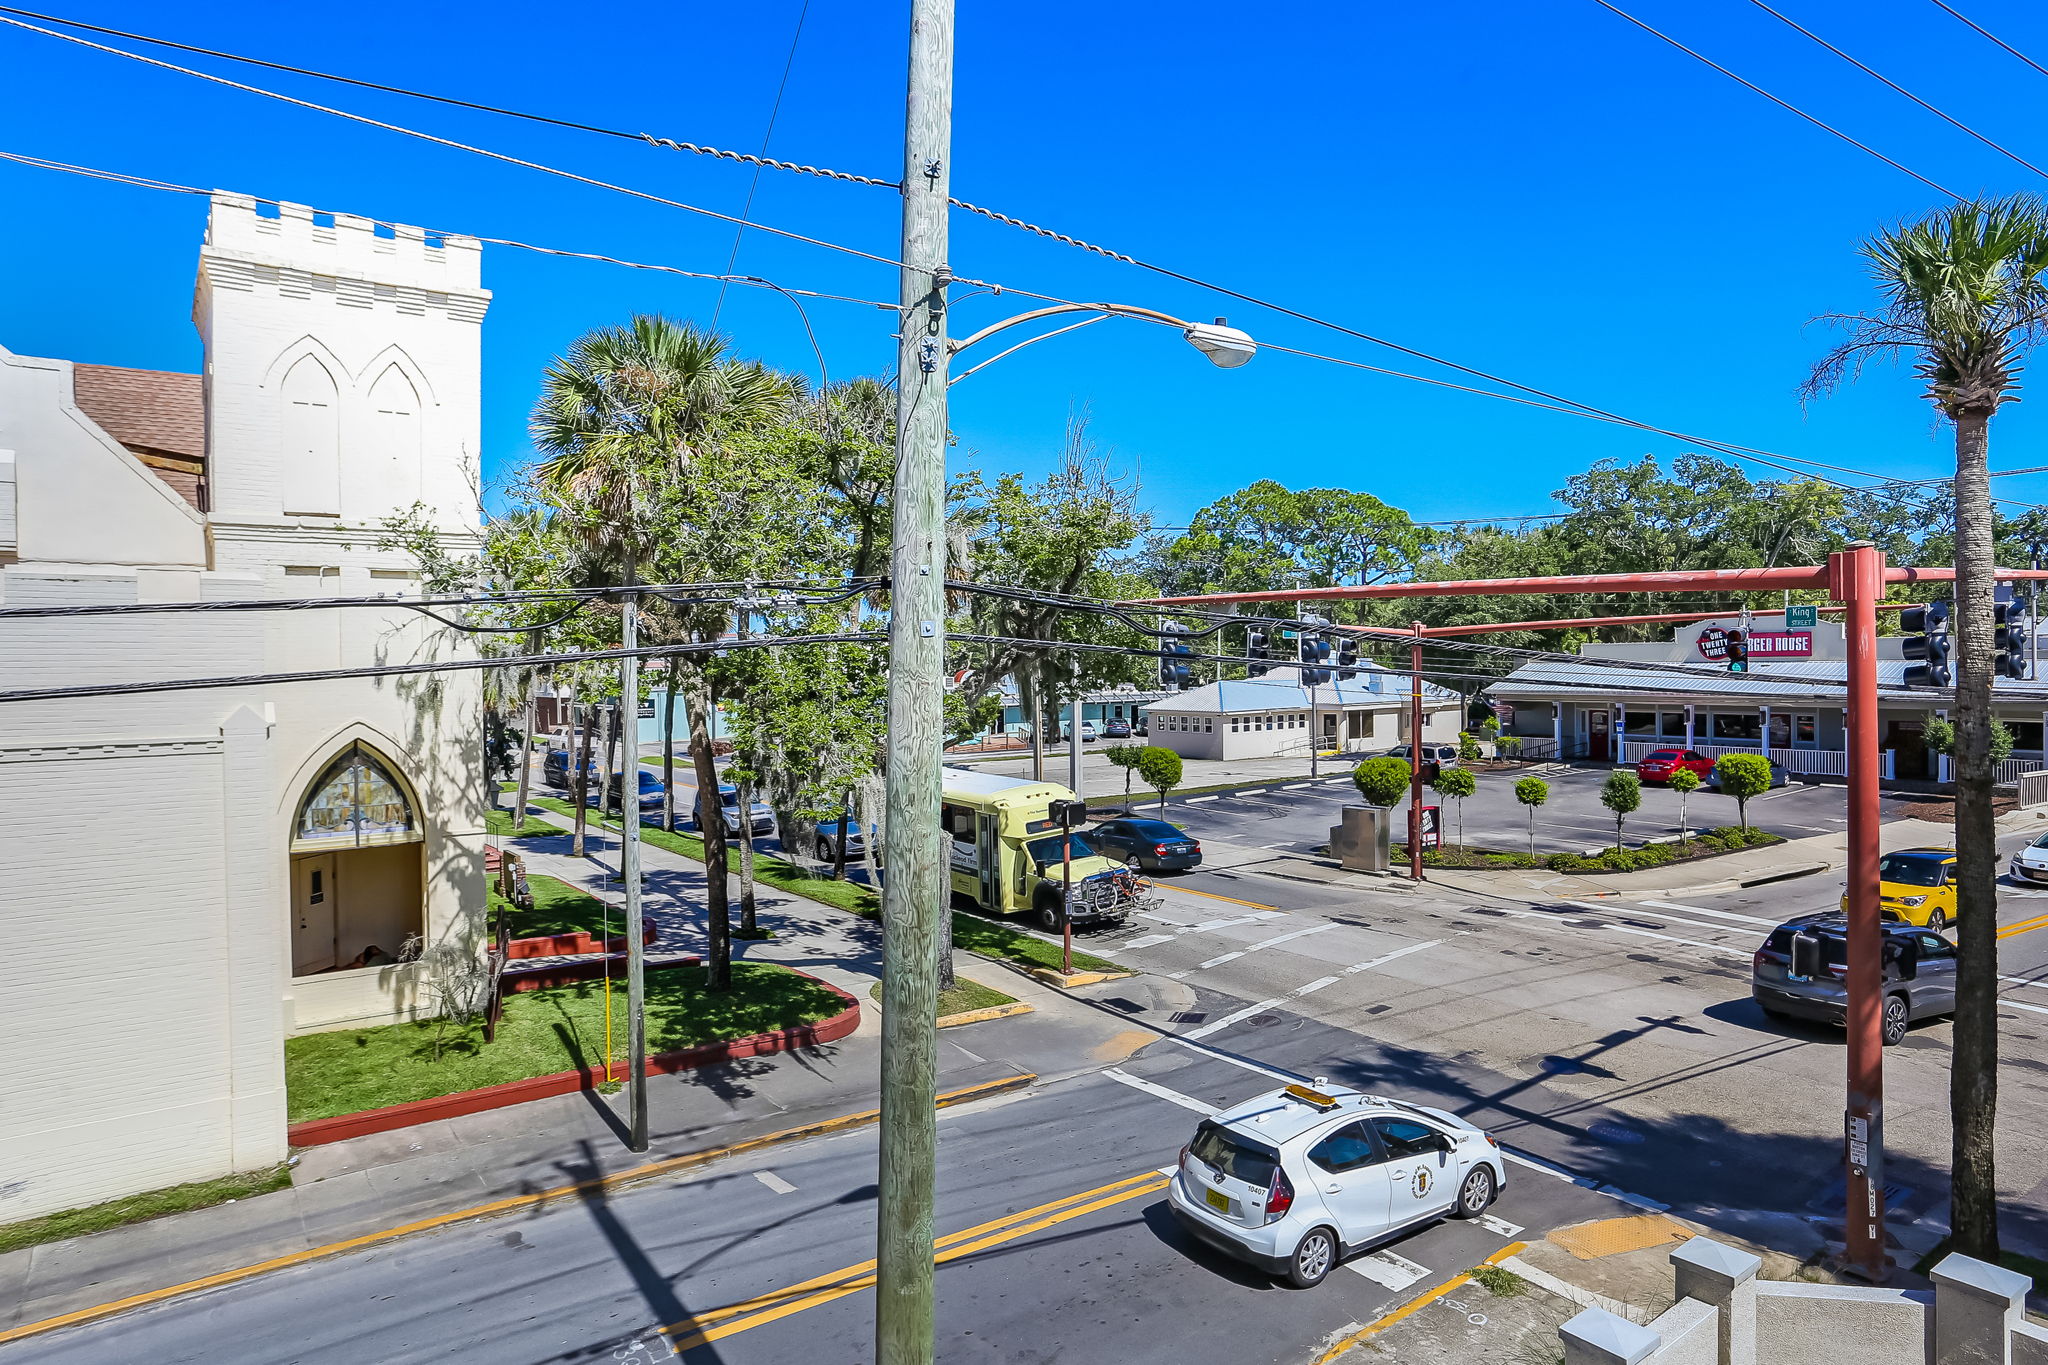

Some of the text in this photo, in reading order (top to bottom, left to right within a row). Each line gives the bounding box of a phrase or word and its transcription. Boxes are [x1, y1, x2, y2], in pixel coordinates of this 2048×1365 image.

[1792, 608, 1810, 617] King
[1709, 631, 1723, 640] ONE
[1701, 638, 1728, 650] TWENTY
[1747, 637, 1809, 652] RGER HOUSE
[1705, 648, 1726, 657] THREE
[1248, 1185, 1266, 1196] 10407
